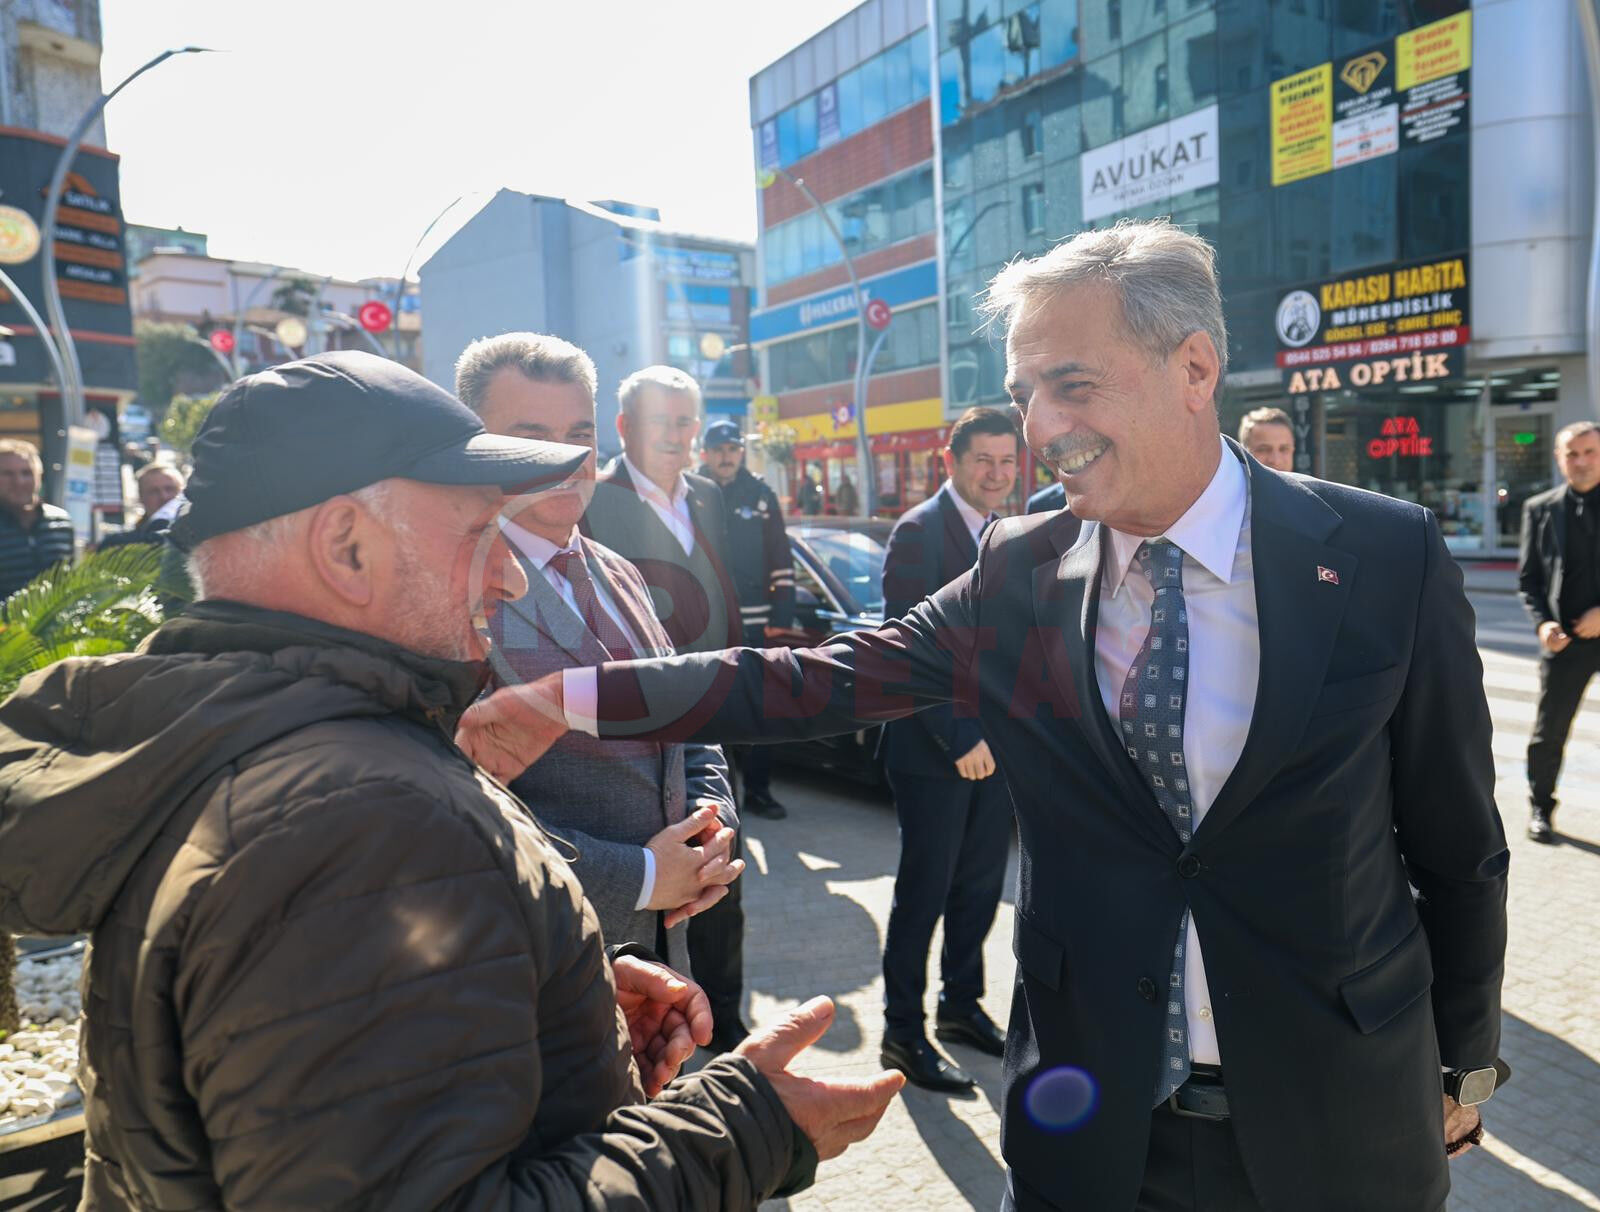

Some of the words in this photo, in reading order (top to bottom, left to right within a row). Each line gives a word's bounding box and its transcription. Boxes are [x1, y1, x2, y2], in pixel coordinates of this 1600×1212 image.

[1091, 132, 1208, 194] AVUKAT
[1320, 273, 1391, 312] KARASU
[1332, 292, 1453, 326] MÜHENDİSLİK
[1288, 367, 1341, 394] ATA
[1350, 350, 1450, 387] OPTİK
[1381, 416, 1420, 436] ATA
[1367, 434, 1433, 459] OPTİK
